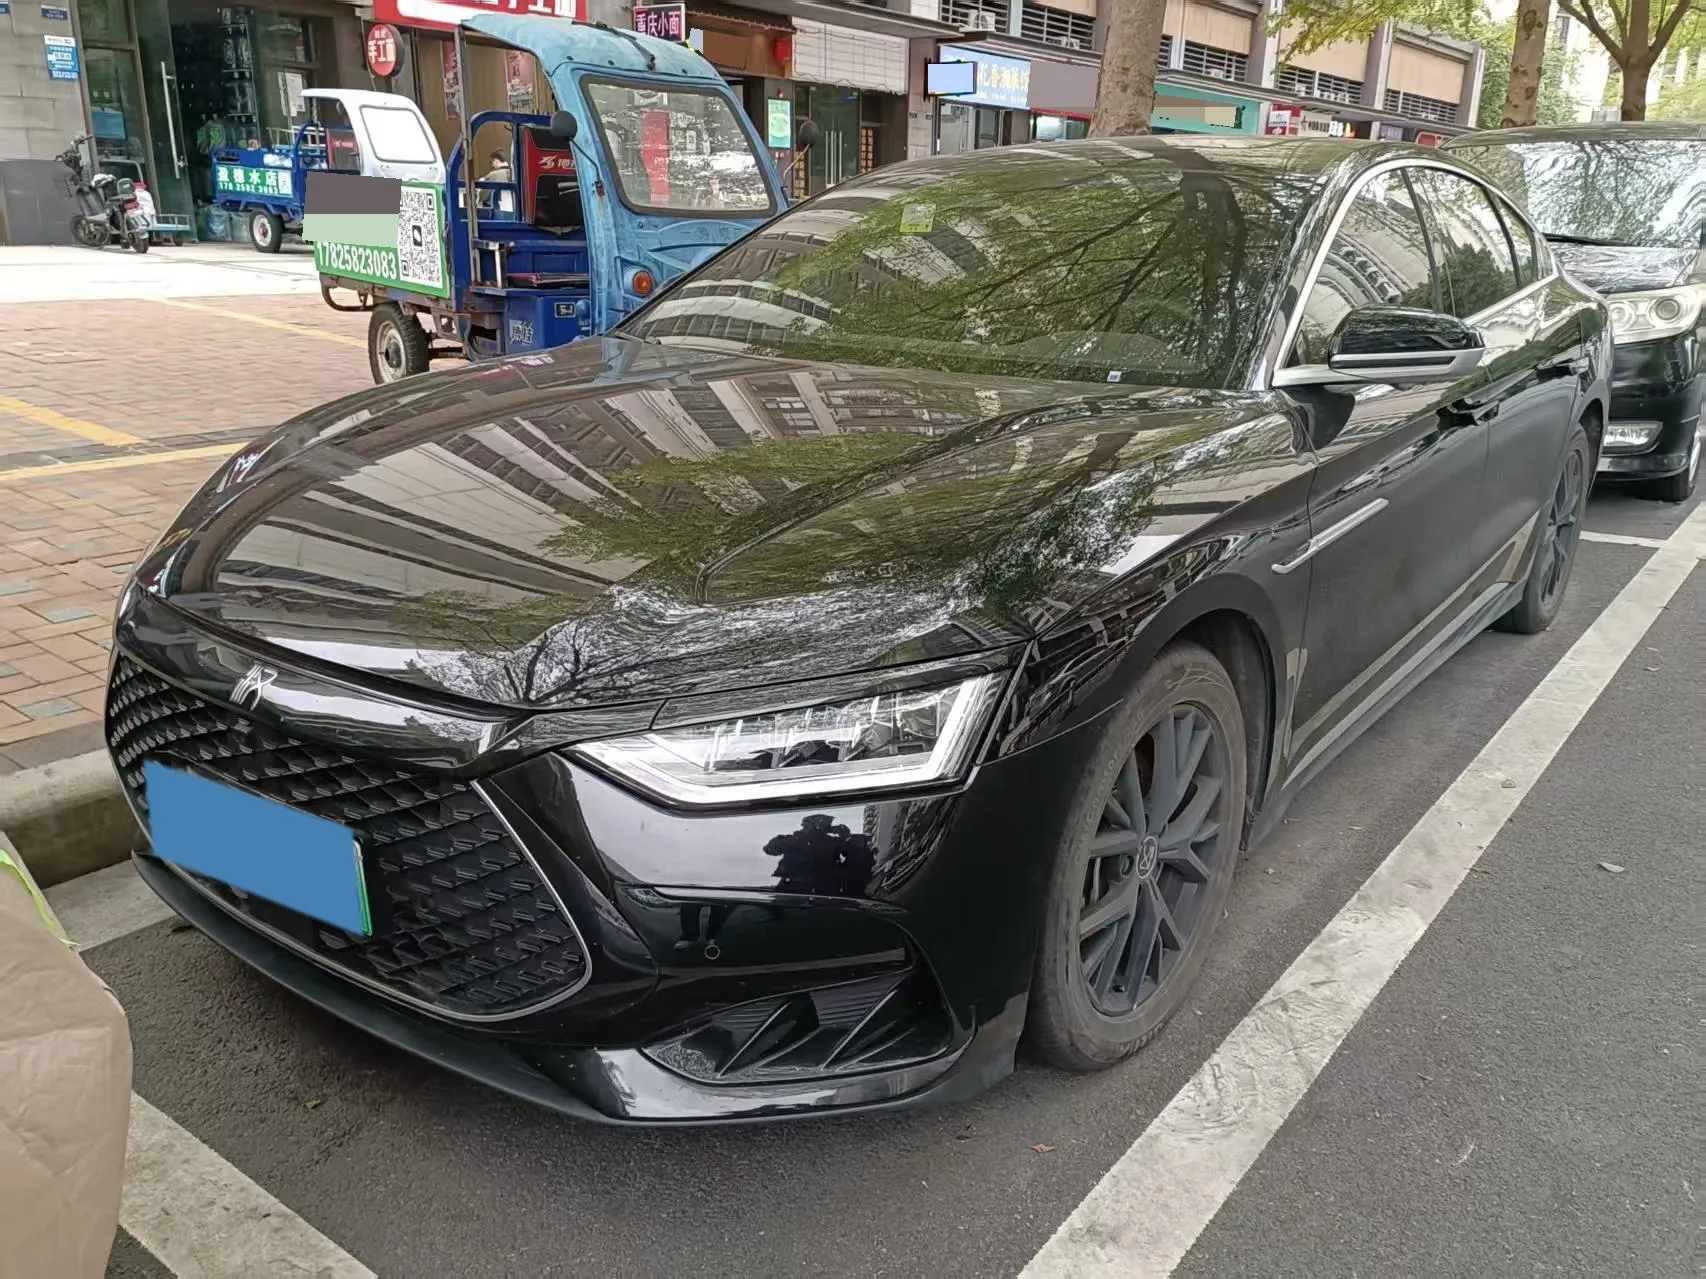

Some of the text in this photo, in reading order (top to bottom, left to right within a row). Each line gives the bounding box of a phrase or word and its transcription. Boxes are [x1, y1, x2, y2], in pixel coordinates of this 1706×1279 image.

[636, 11, 680, 36] 重庆小面
[368, 39, 395, 63] 手工面
[316, 240, 397, 279] 17825823083
